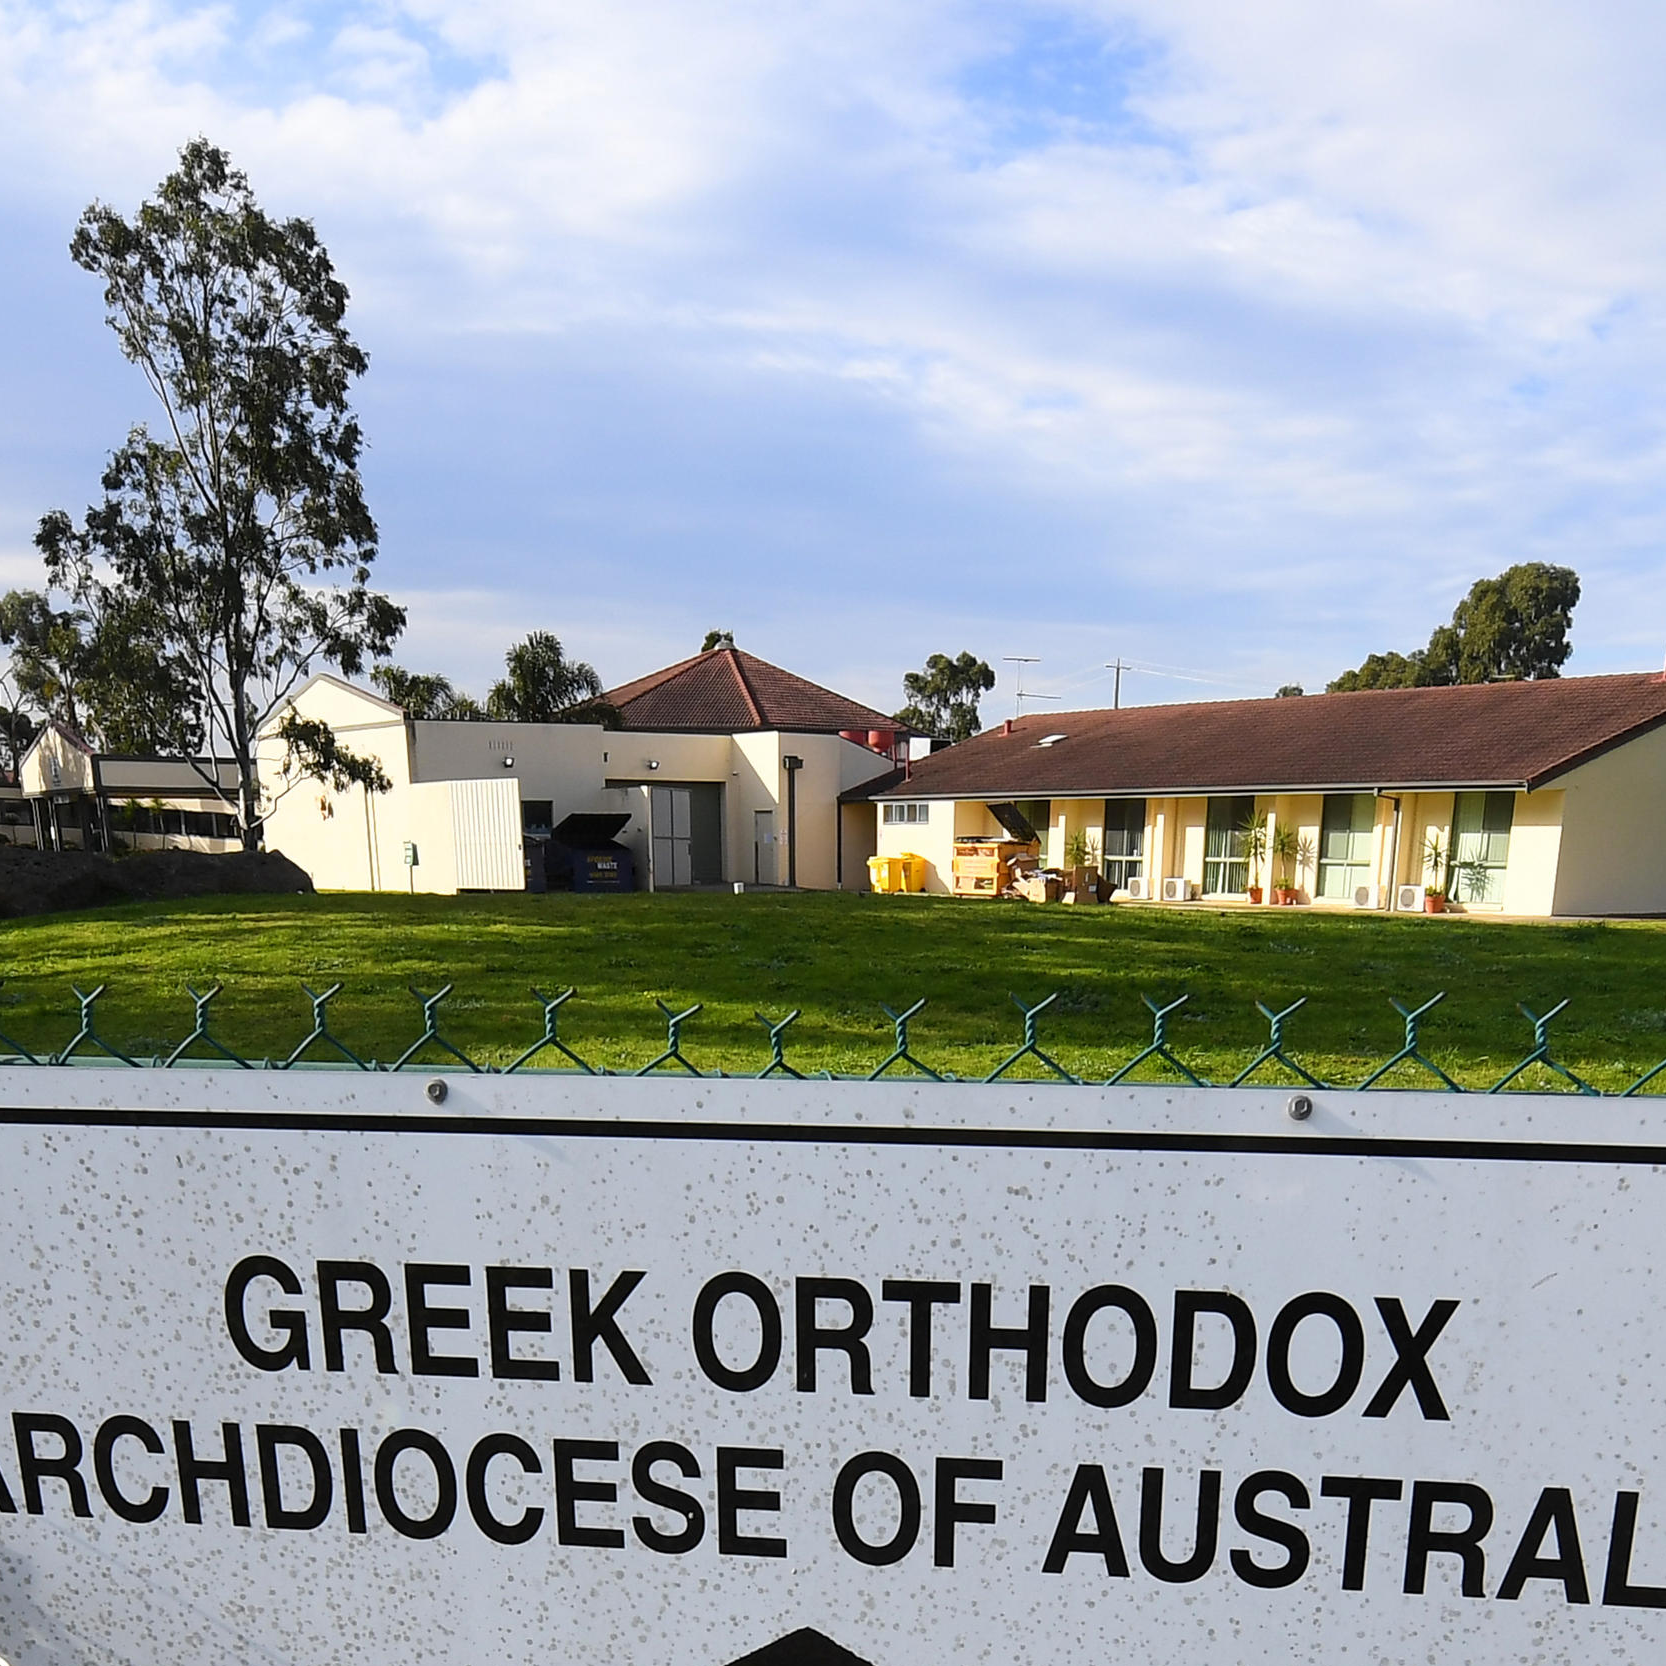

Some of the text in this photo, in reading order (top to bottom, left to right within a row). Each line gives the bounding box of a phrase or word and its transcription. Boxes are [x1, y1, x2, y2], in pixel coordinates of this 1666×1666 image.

[223, 1254, 1460, 1422] GREEK ORTHODOX
[831, 1450, 1004, 1569] OF
